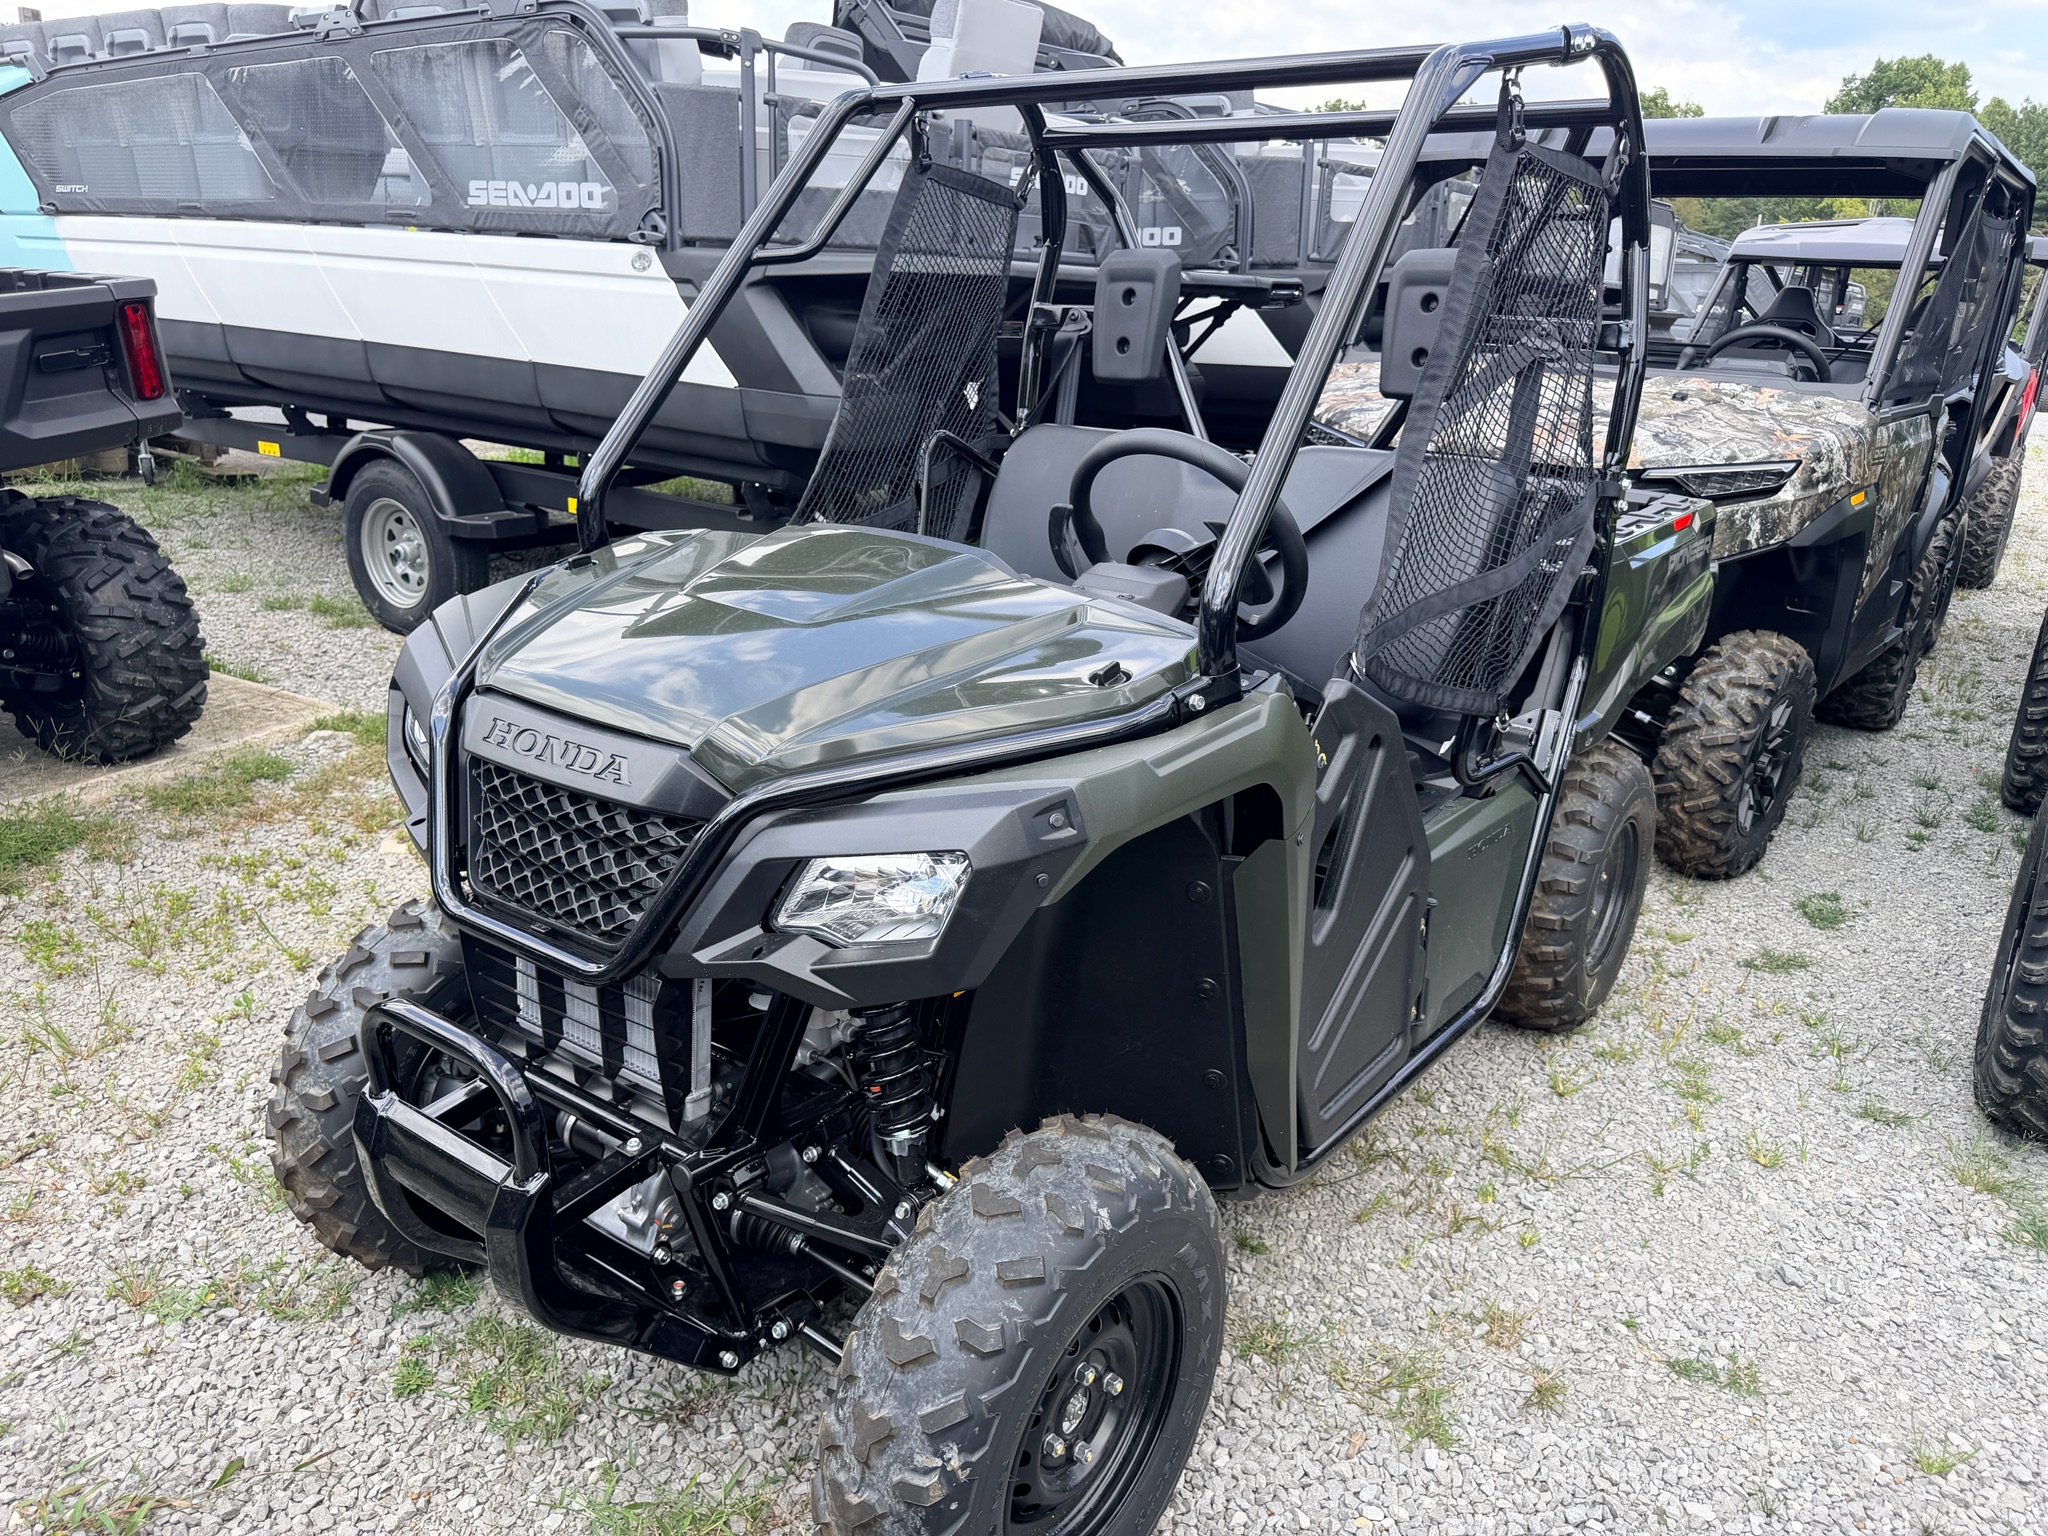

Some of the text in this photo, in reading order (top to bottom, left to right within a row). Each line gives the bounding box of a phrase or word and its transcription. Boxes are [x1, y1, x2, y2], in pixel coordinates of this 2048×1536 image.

[55, 184, 89, 193] SWITCH
[1667, 534, 1713, 575] PIONEER
[482, 717, 633, 786] HONDA
